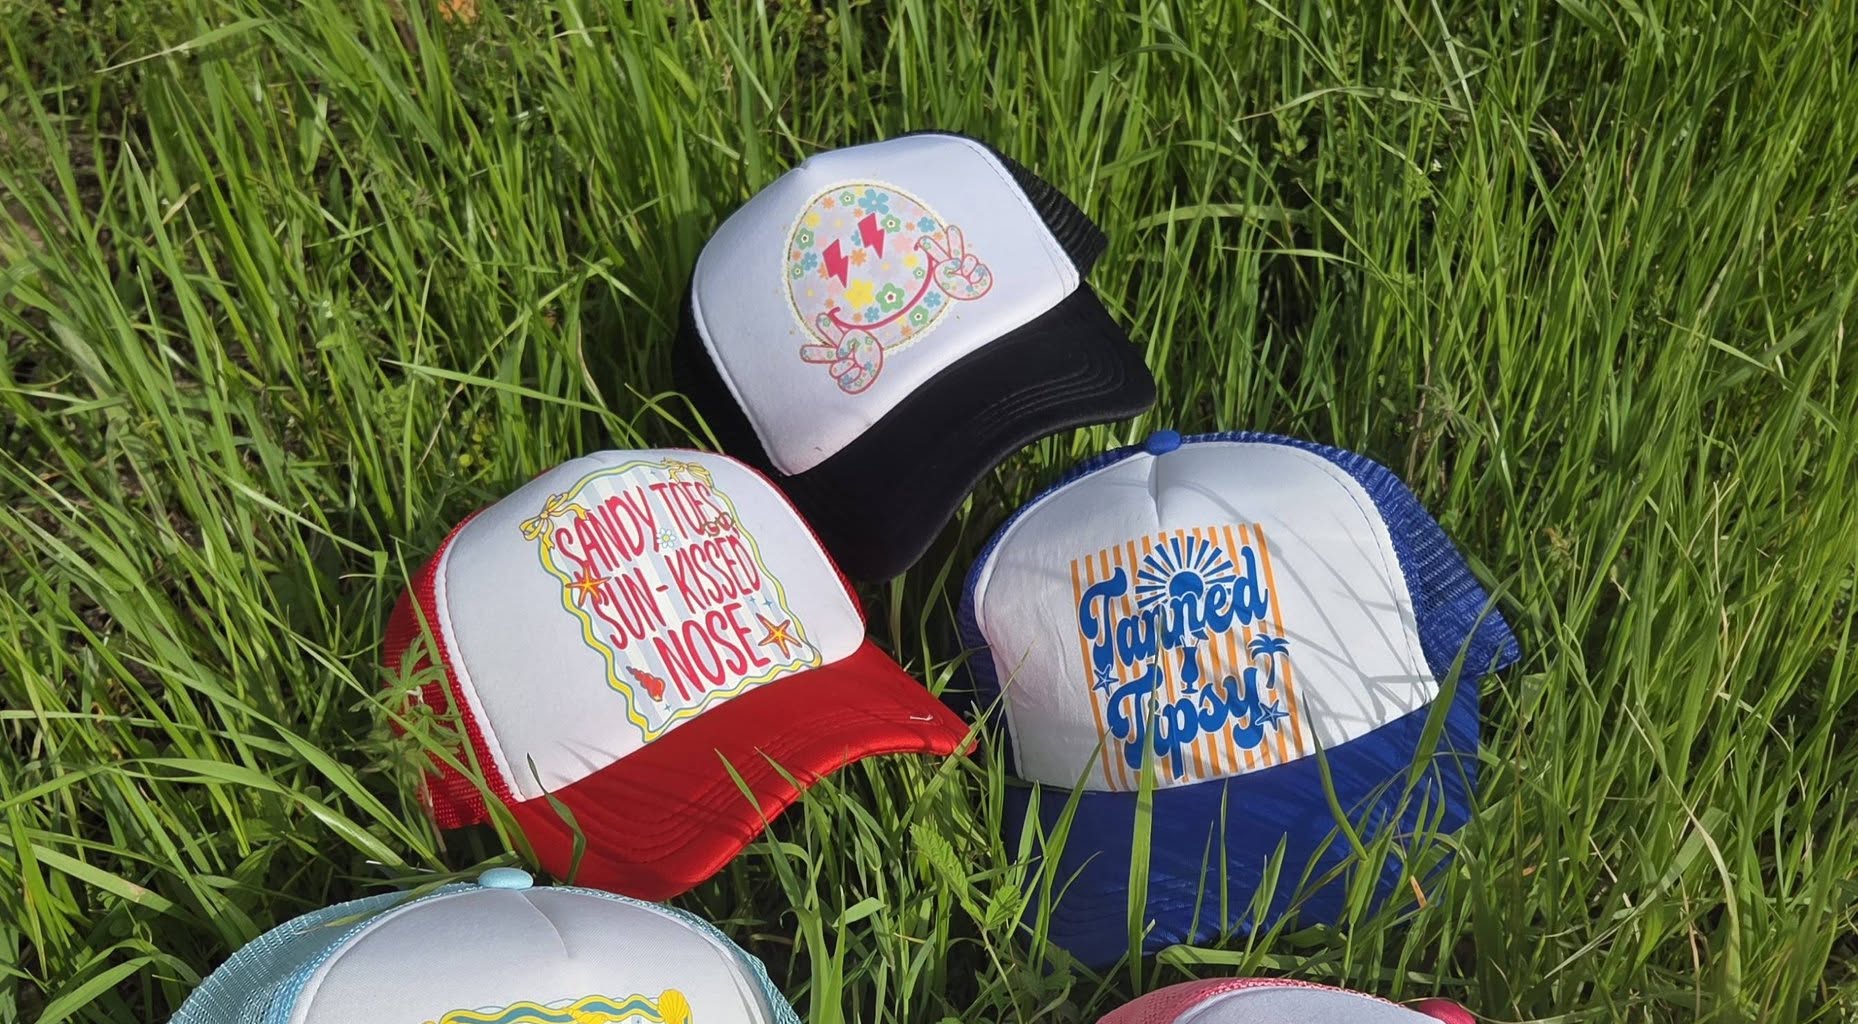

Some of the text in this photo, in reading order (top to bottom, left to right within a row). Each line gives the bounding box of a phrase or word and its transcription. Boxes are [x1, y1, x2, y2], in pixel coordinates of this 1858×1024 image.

[555, 485, 660, 584] SANDY
[652, 602, 771, 702] NOSE
[1079, 545, 1269, 671] Tanned
[1107, 663, 1265, 780] Tipsy
